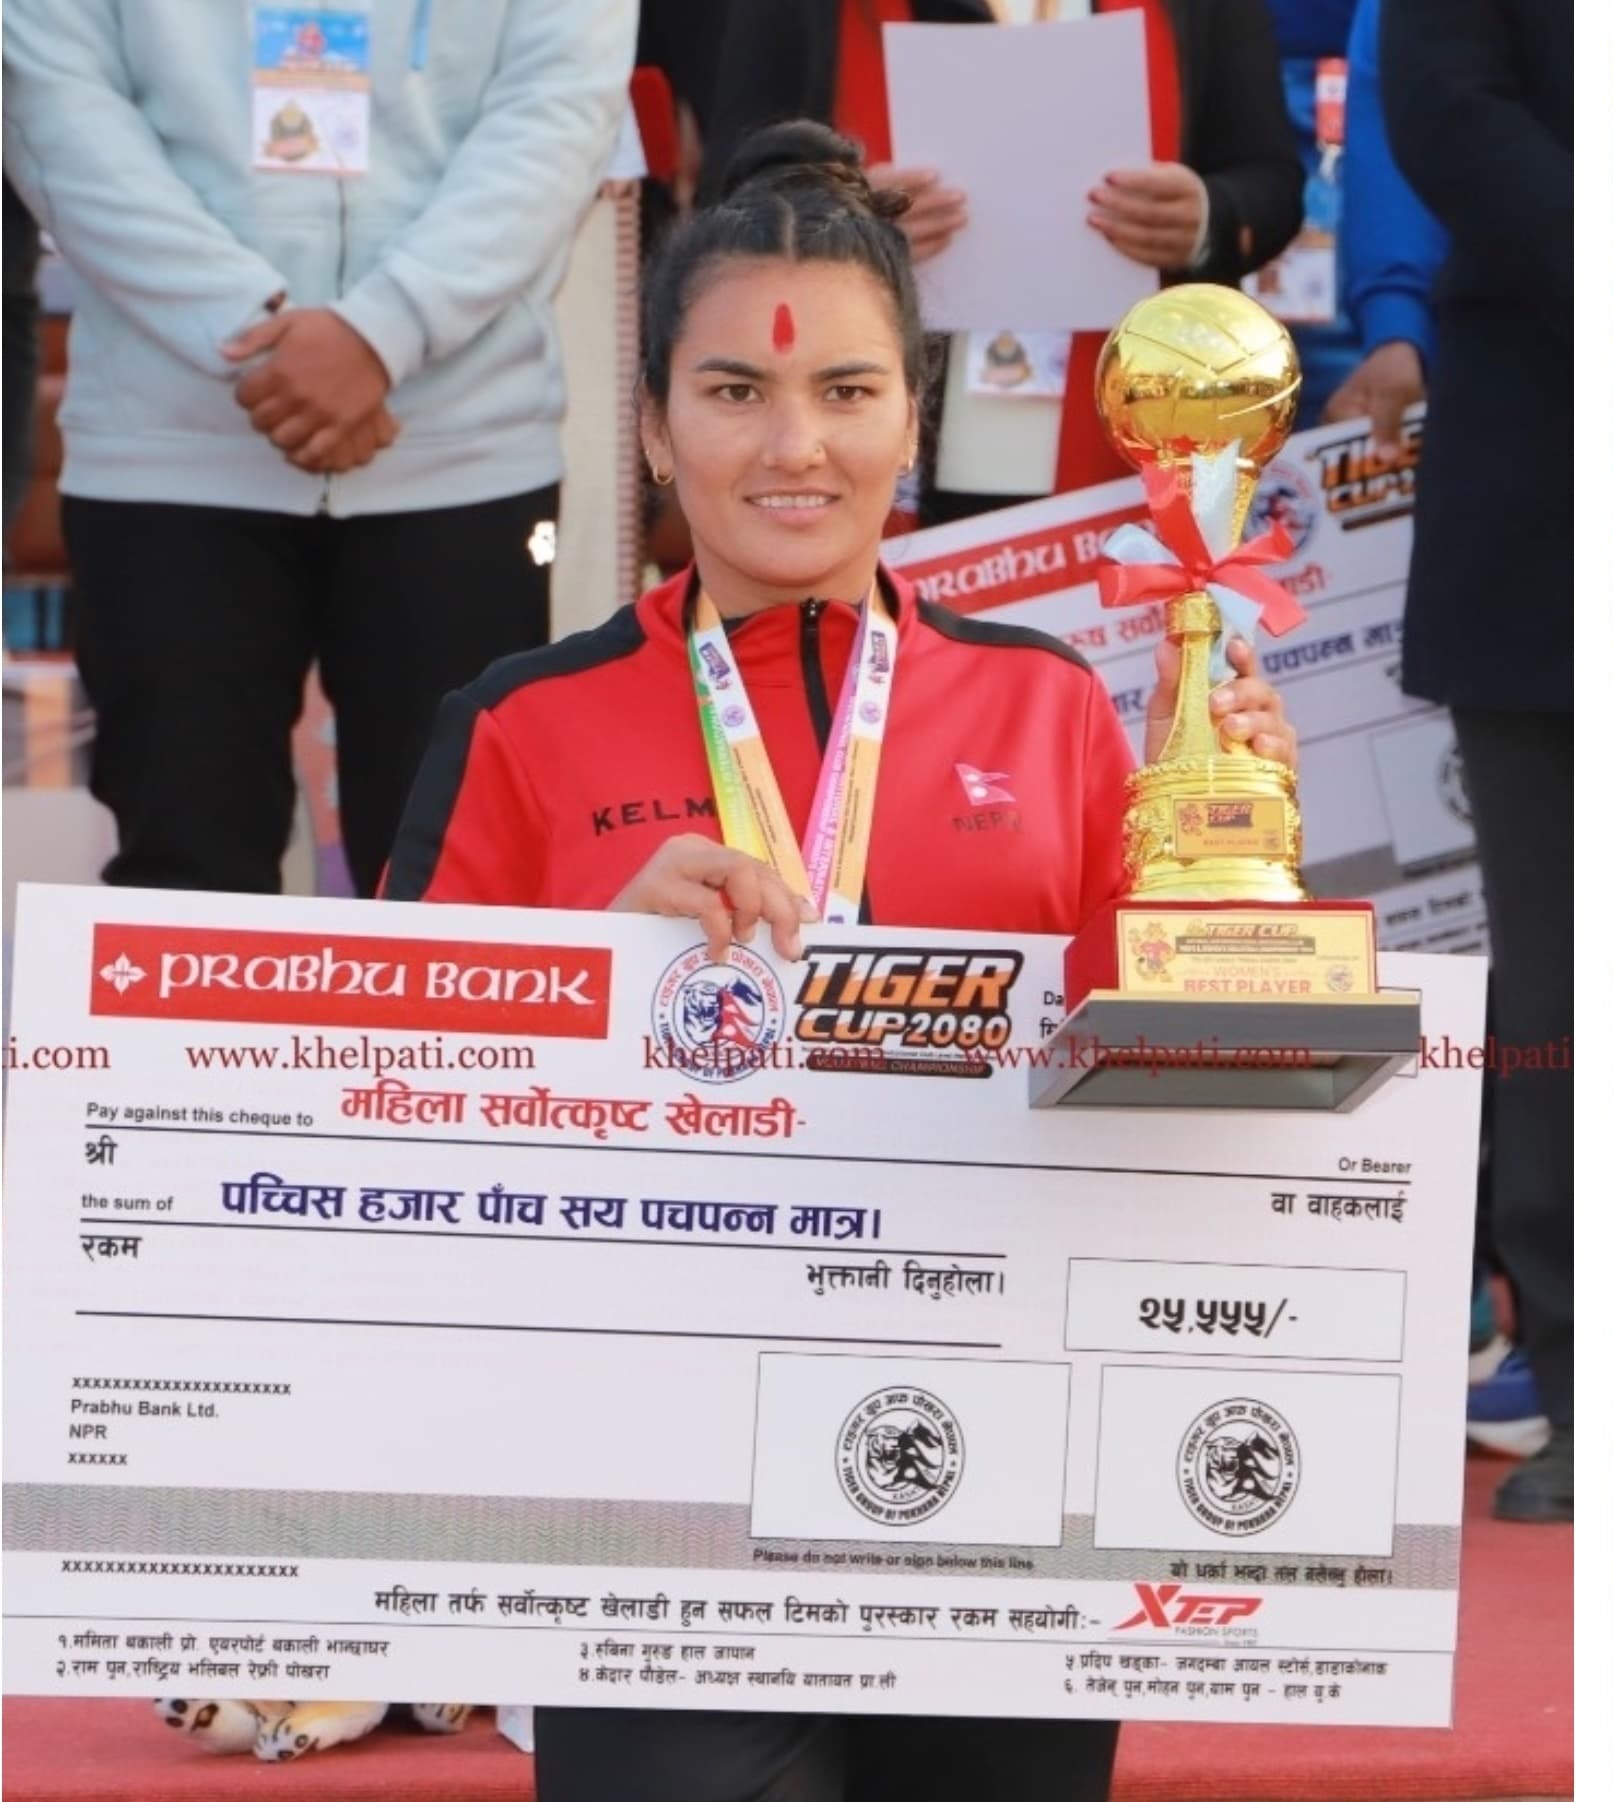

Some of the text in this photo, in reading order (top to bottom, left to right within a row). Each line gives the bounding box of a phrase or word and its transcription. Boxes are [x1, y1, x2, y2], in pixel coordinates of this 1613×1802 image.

[592, 797, 716, 836] KELM
[802, 953, 1014, 1009] TIGER
[1236, 980, 1312, 994] PLAYER
[798, 1008, 1010, 1047] CUP2080
[87, 1102, 314, 1128] Pay against this cheque to
[341, 1078, 467, 1125] महिला
[85, 1135, 116, 1165] श्री
[1338, 1157, 1412, 1175] Or Bearer
[81, 1194, 173, 1212] the sum of
[358, 1186, 464, 1224] हजार
[559, 1195, 628, 1230] सय
[640, 1198, 778, 1235] पचपन्न
[1271, 1192, 1296, 1216] वा
[80, 1234, 142, 1262] रकम
[70, 1399, 219, 1418] Prabhu Bank Ltd.
[69, 1424, 107, 1440] NPR
[752, 1549, 798, 1563] Please
[803, 1550, 820, 1563] do
[823, 1551, 846, 1564] not
[850, 1552, 883, 1565] write
[886, 1555, 900, 1566] or
[904, 1553, 934, 1569] sign
[937, 1554, 977, 1568] below
[980, 1555, 1005, 1569] this
[375, 1584, 437, 1617] महिला
[448, 1589, 486, 1614] तर्फ
[680, 1600, 706, 1628] हुन
[718, 1600, 774, 1623] सफल
[785, 1596, 848, 1624] टिमको
[859, 1604, 940, 1631] पुरस्कार
[948, 1607, 998, 1630] रकम
[1112, 1582, 1263, 1628] XTEP
[1175, 1627, 1258, 1638] FASHION SPORTS
